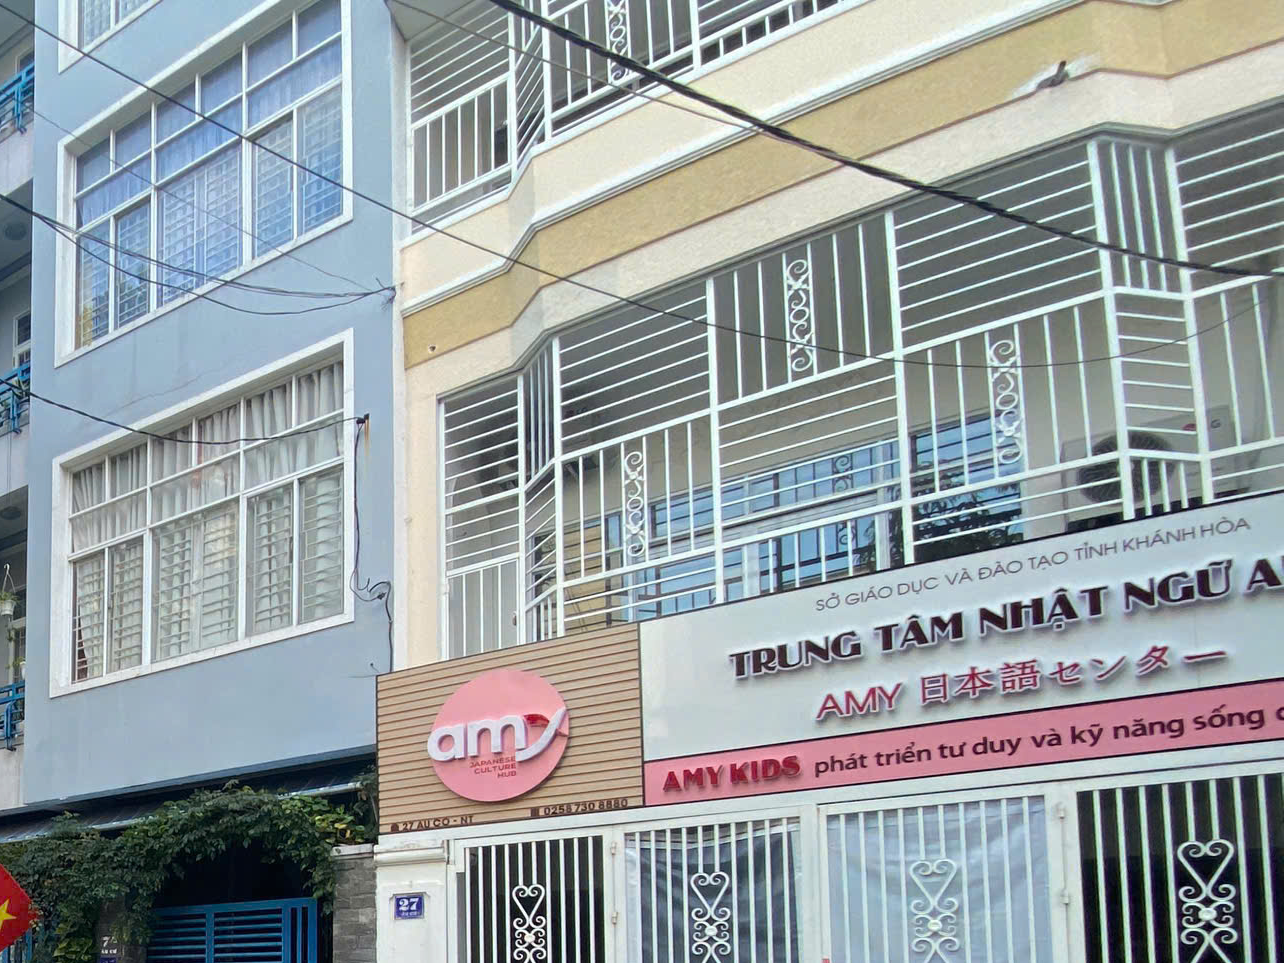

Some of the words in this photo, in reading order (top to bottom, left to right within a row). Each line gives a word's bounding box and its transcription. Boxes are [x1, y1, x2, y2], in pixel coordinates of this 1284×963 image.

[816, 592, 840, 611] SỞ
[845, 586, 893, 606] GIÁO
[897, 577, 939, 595] DỤC
[945, 568, 973, 585] VÀ
[979, 560, 1023, 580] ĐÀO
[1028, 551, 1068, 570] TẠO
[1074, 542, 1118, 561] TỈNH
[1123, 526, 1196, 552] KHÁNH
[1200, 516, 1251, 538] HÒA
[729, 630, 862, 678] TRUNG
[874, 612, 964, 651] TÂM
[979, 585, 1109, 634] NHẬT
[1124, 558, 1234, 610] NGỮ
[1247, 554, 1284, 591] A
[816, 682, 903, 719] AMY
[920, 645, 1227, 704] 日本語センター
[427, 706, 566, 763] amy
[662, 764, 722, 792] AMY
[729, 755, 801, 785] KIDS
[815, 751, 868, 777] phát
[875, 741, 932, 767] triển
[939, 742, 966, 759] tư
[972, 737, 1021, 755] duy
[1031, 728, 1062, 748] và
[1070, 723, 1103, 747] kỹ
[1113, 717, 1185, 739] năng
[1193, 703, 1265, 730] sống
[469, 756, 516, 768] JAPANESE
[474, 763, 516, 774] CULTURE
[497, 770, 517, 778] HUB
[544, 804, 573, 816] 0258
[574, 802, 596, 813] 730
[402, 823, 414, 832] 27
[398, 897, 419, 912] 27
